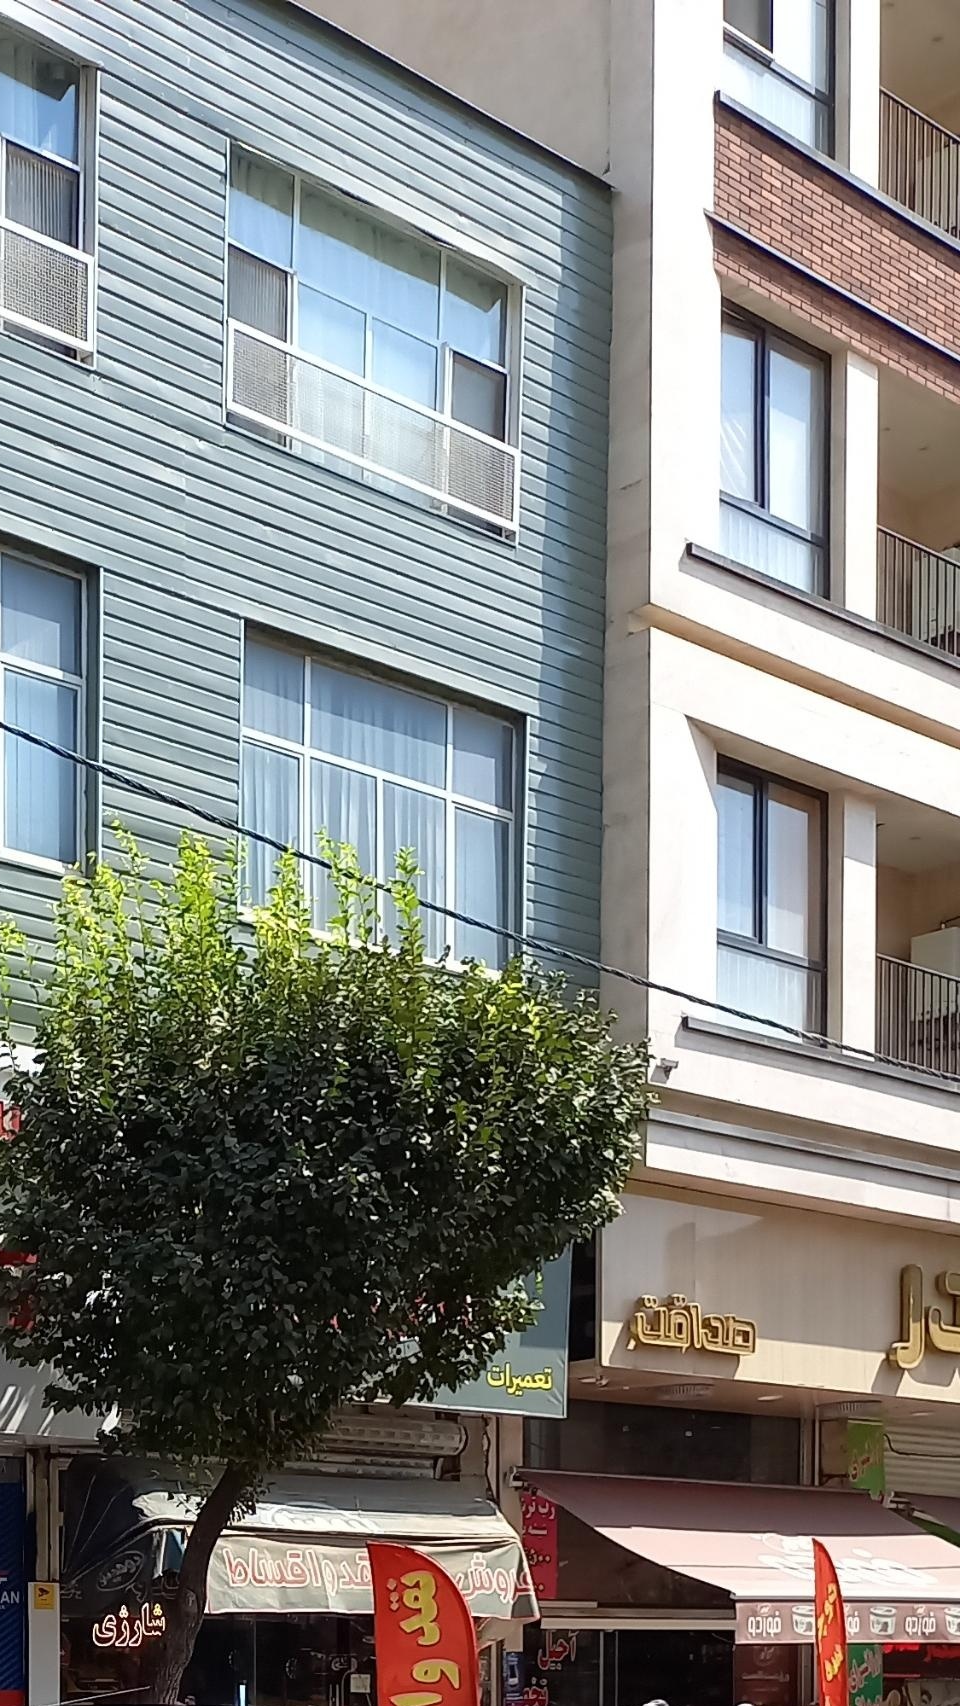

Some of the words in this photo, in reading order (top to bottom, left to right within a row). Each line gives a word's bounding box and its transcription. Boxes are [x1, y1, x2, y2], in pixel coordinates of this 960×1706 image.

[634, 1293, 757, 1355] صداقت
[486, 1362, 553, 1396] تعمیرات
[92, 1602, 166, 1647] شارژی
[386, 1569, 440, 1647] نقد
[412, 1658, 460, 1690] و
